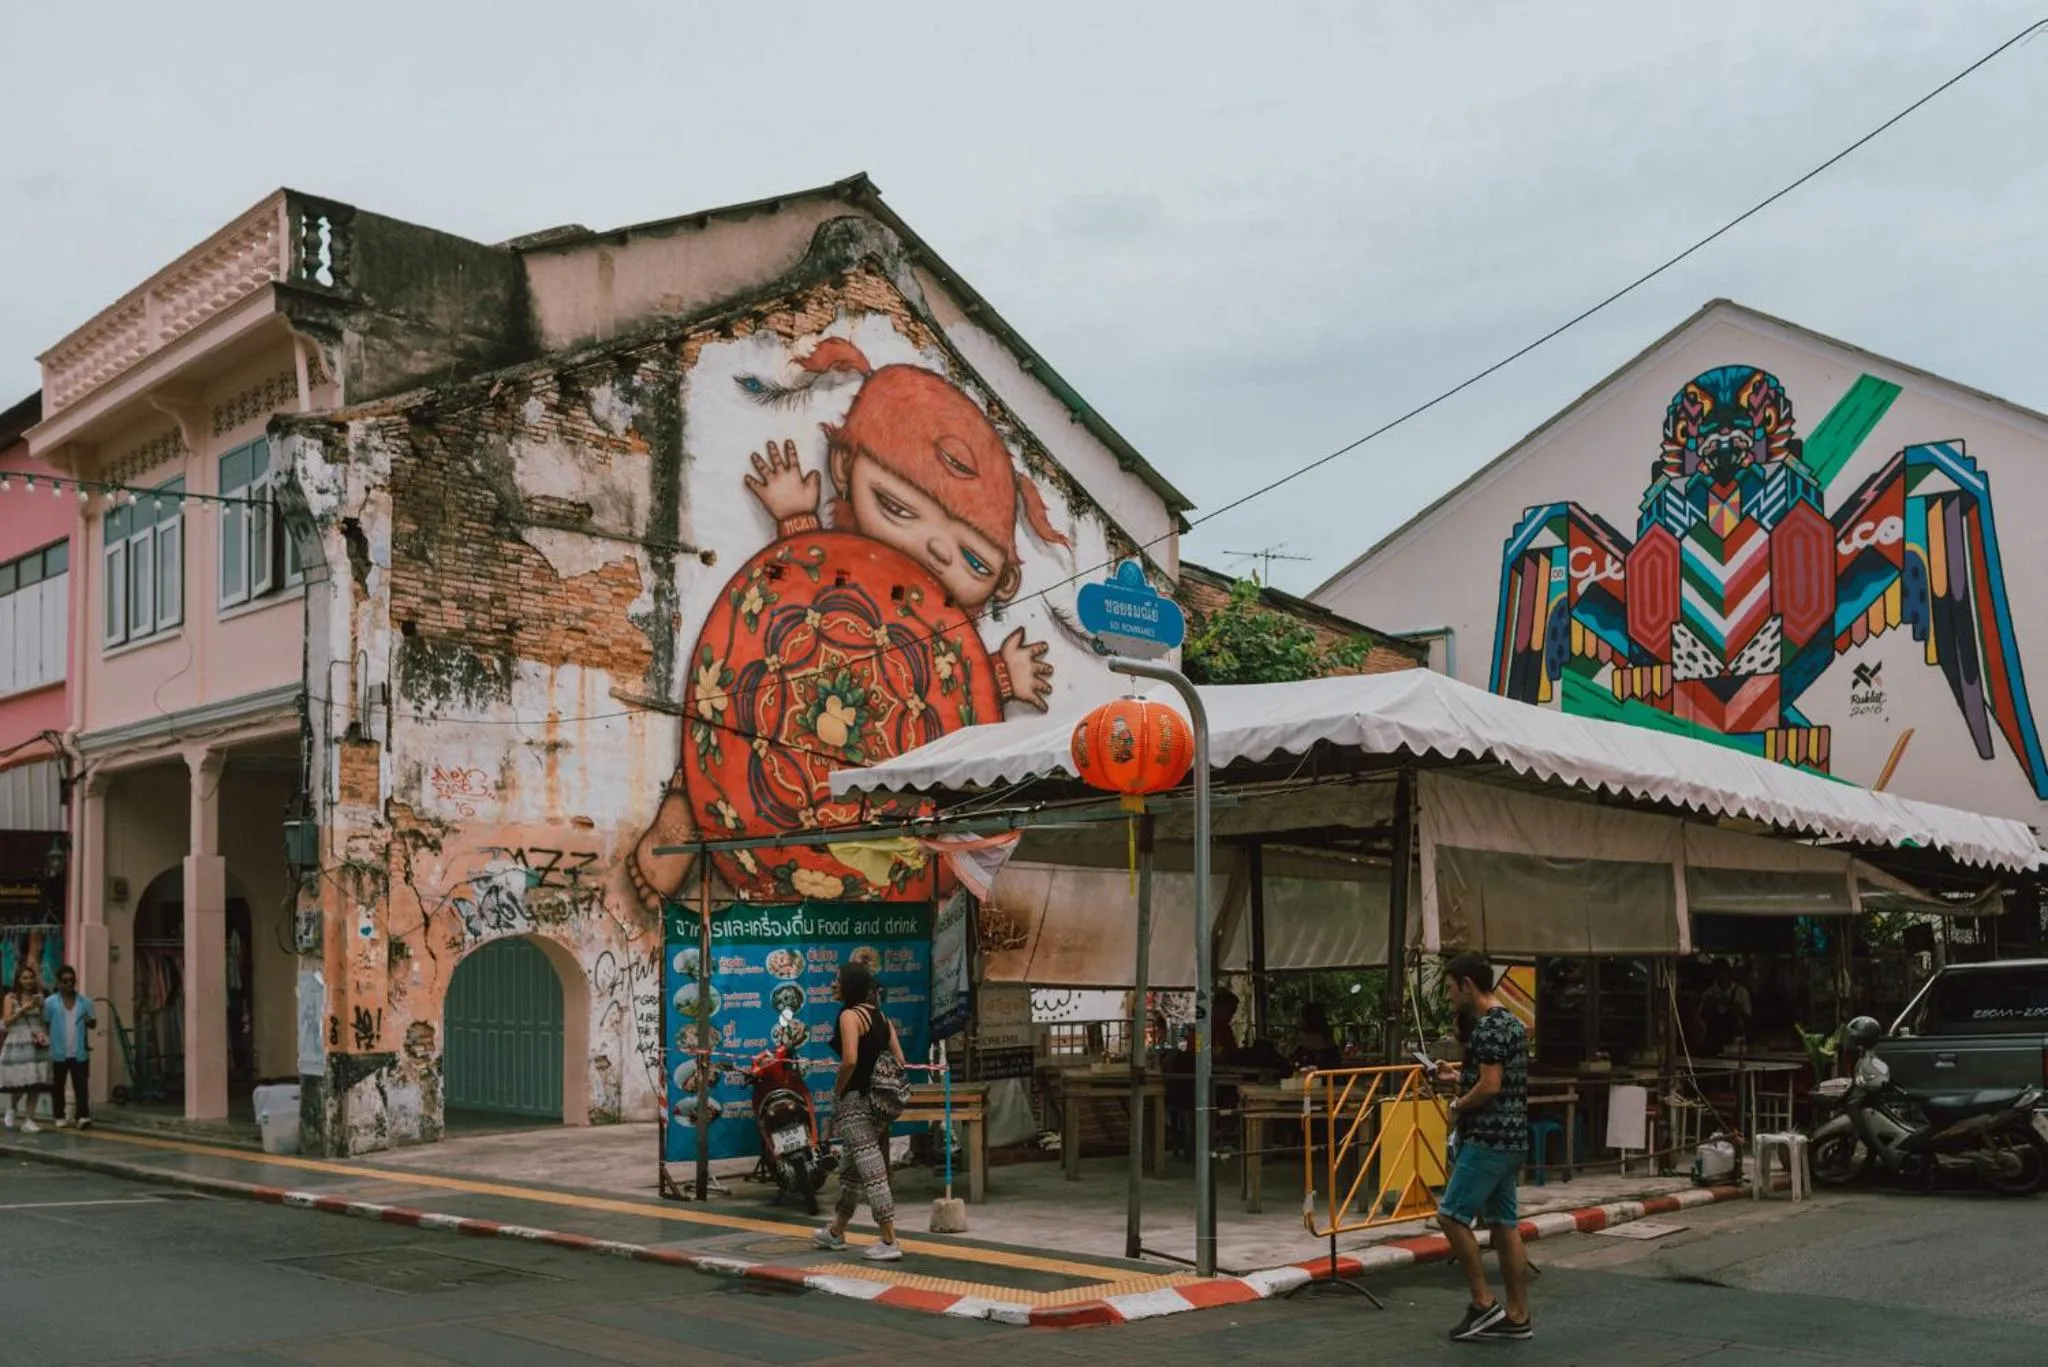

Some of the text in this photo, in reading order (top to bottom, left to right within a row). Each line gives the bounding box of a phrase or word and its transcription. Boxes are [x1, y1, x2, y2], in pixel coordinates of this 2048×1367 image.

[676, 908, 918, 938] อาหรและเครื่องดื่ม Food and drink
